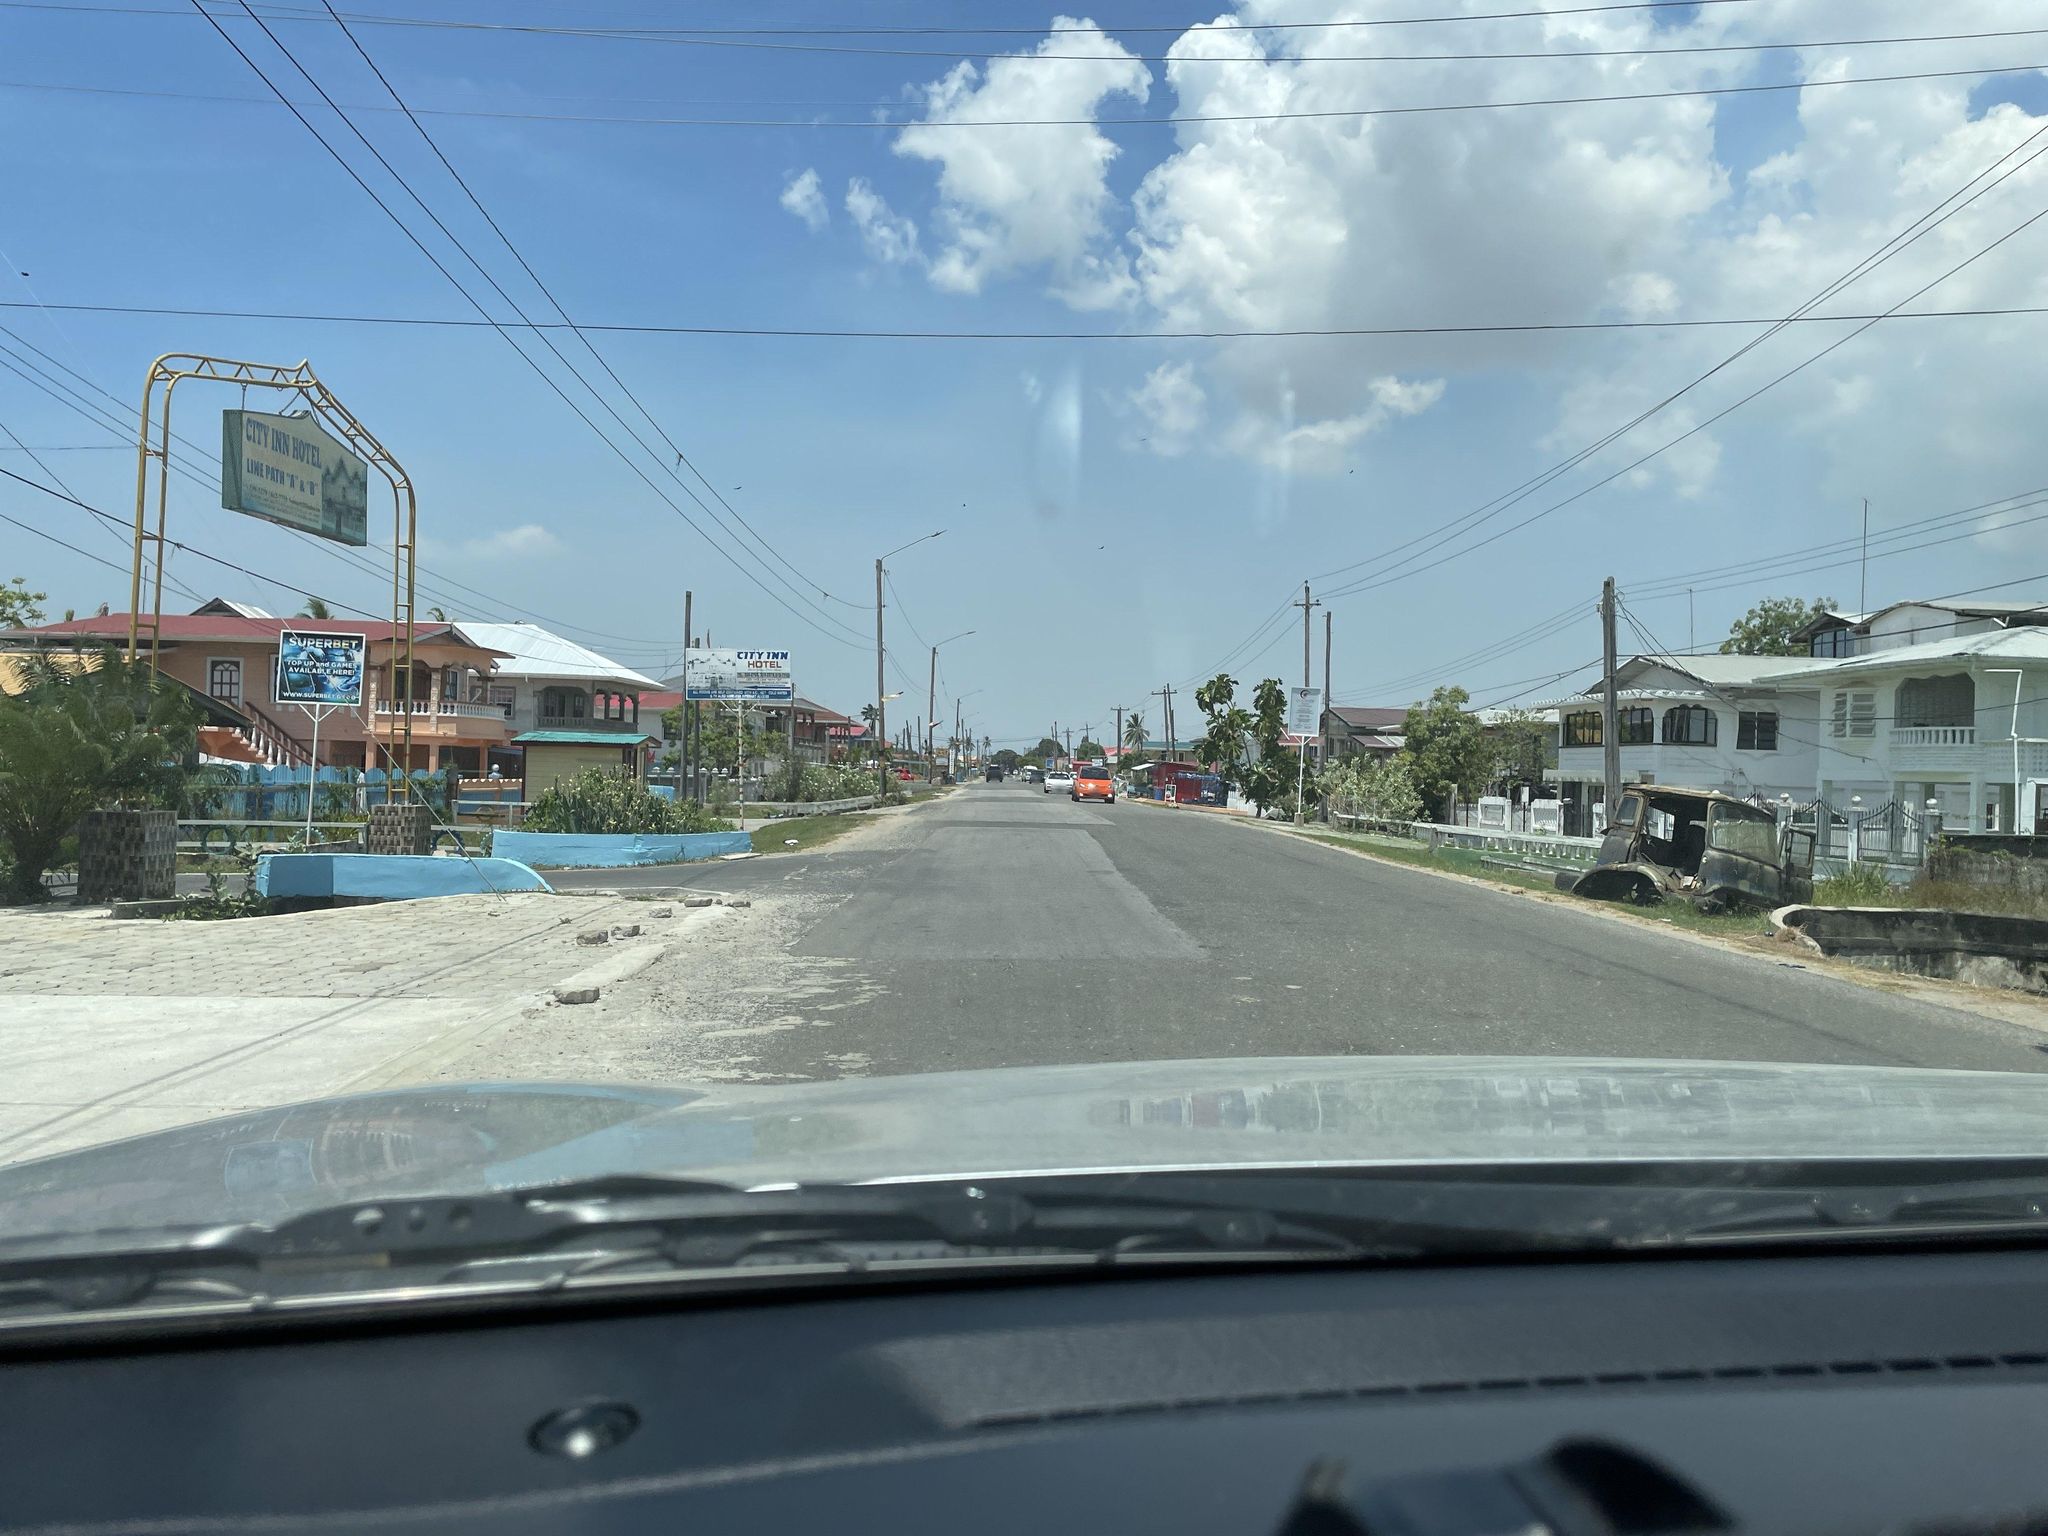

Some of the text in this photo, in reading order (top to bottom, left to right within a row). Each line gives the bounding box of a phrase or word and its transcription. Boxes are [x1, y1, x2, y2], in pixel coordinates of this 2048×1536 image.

[246, 417, 321, 469] CITY INN HOTEL
[247, 458, 264, 478] LIME
[265, 464, 285, 485] PATH
[300, 479, 305, 492] &
[289, 637, 358, 649] SUPERBET
[737, 651, 789, 660] CITY INN
[331, 661, 357, 669] GAMES
[747, 660, 782, 669] HOTEL
[288, 666, 332, 675] AVAILABLE
